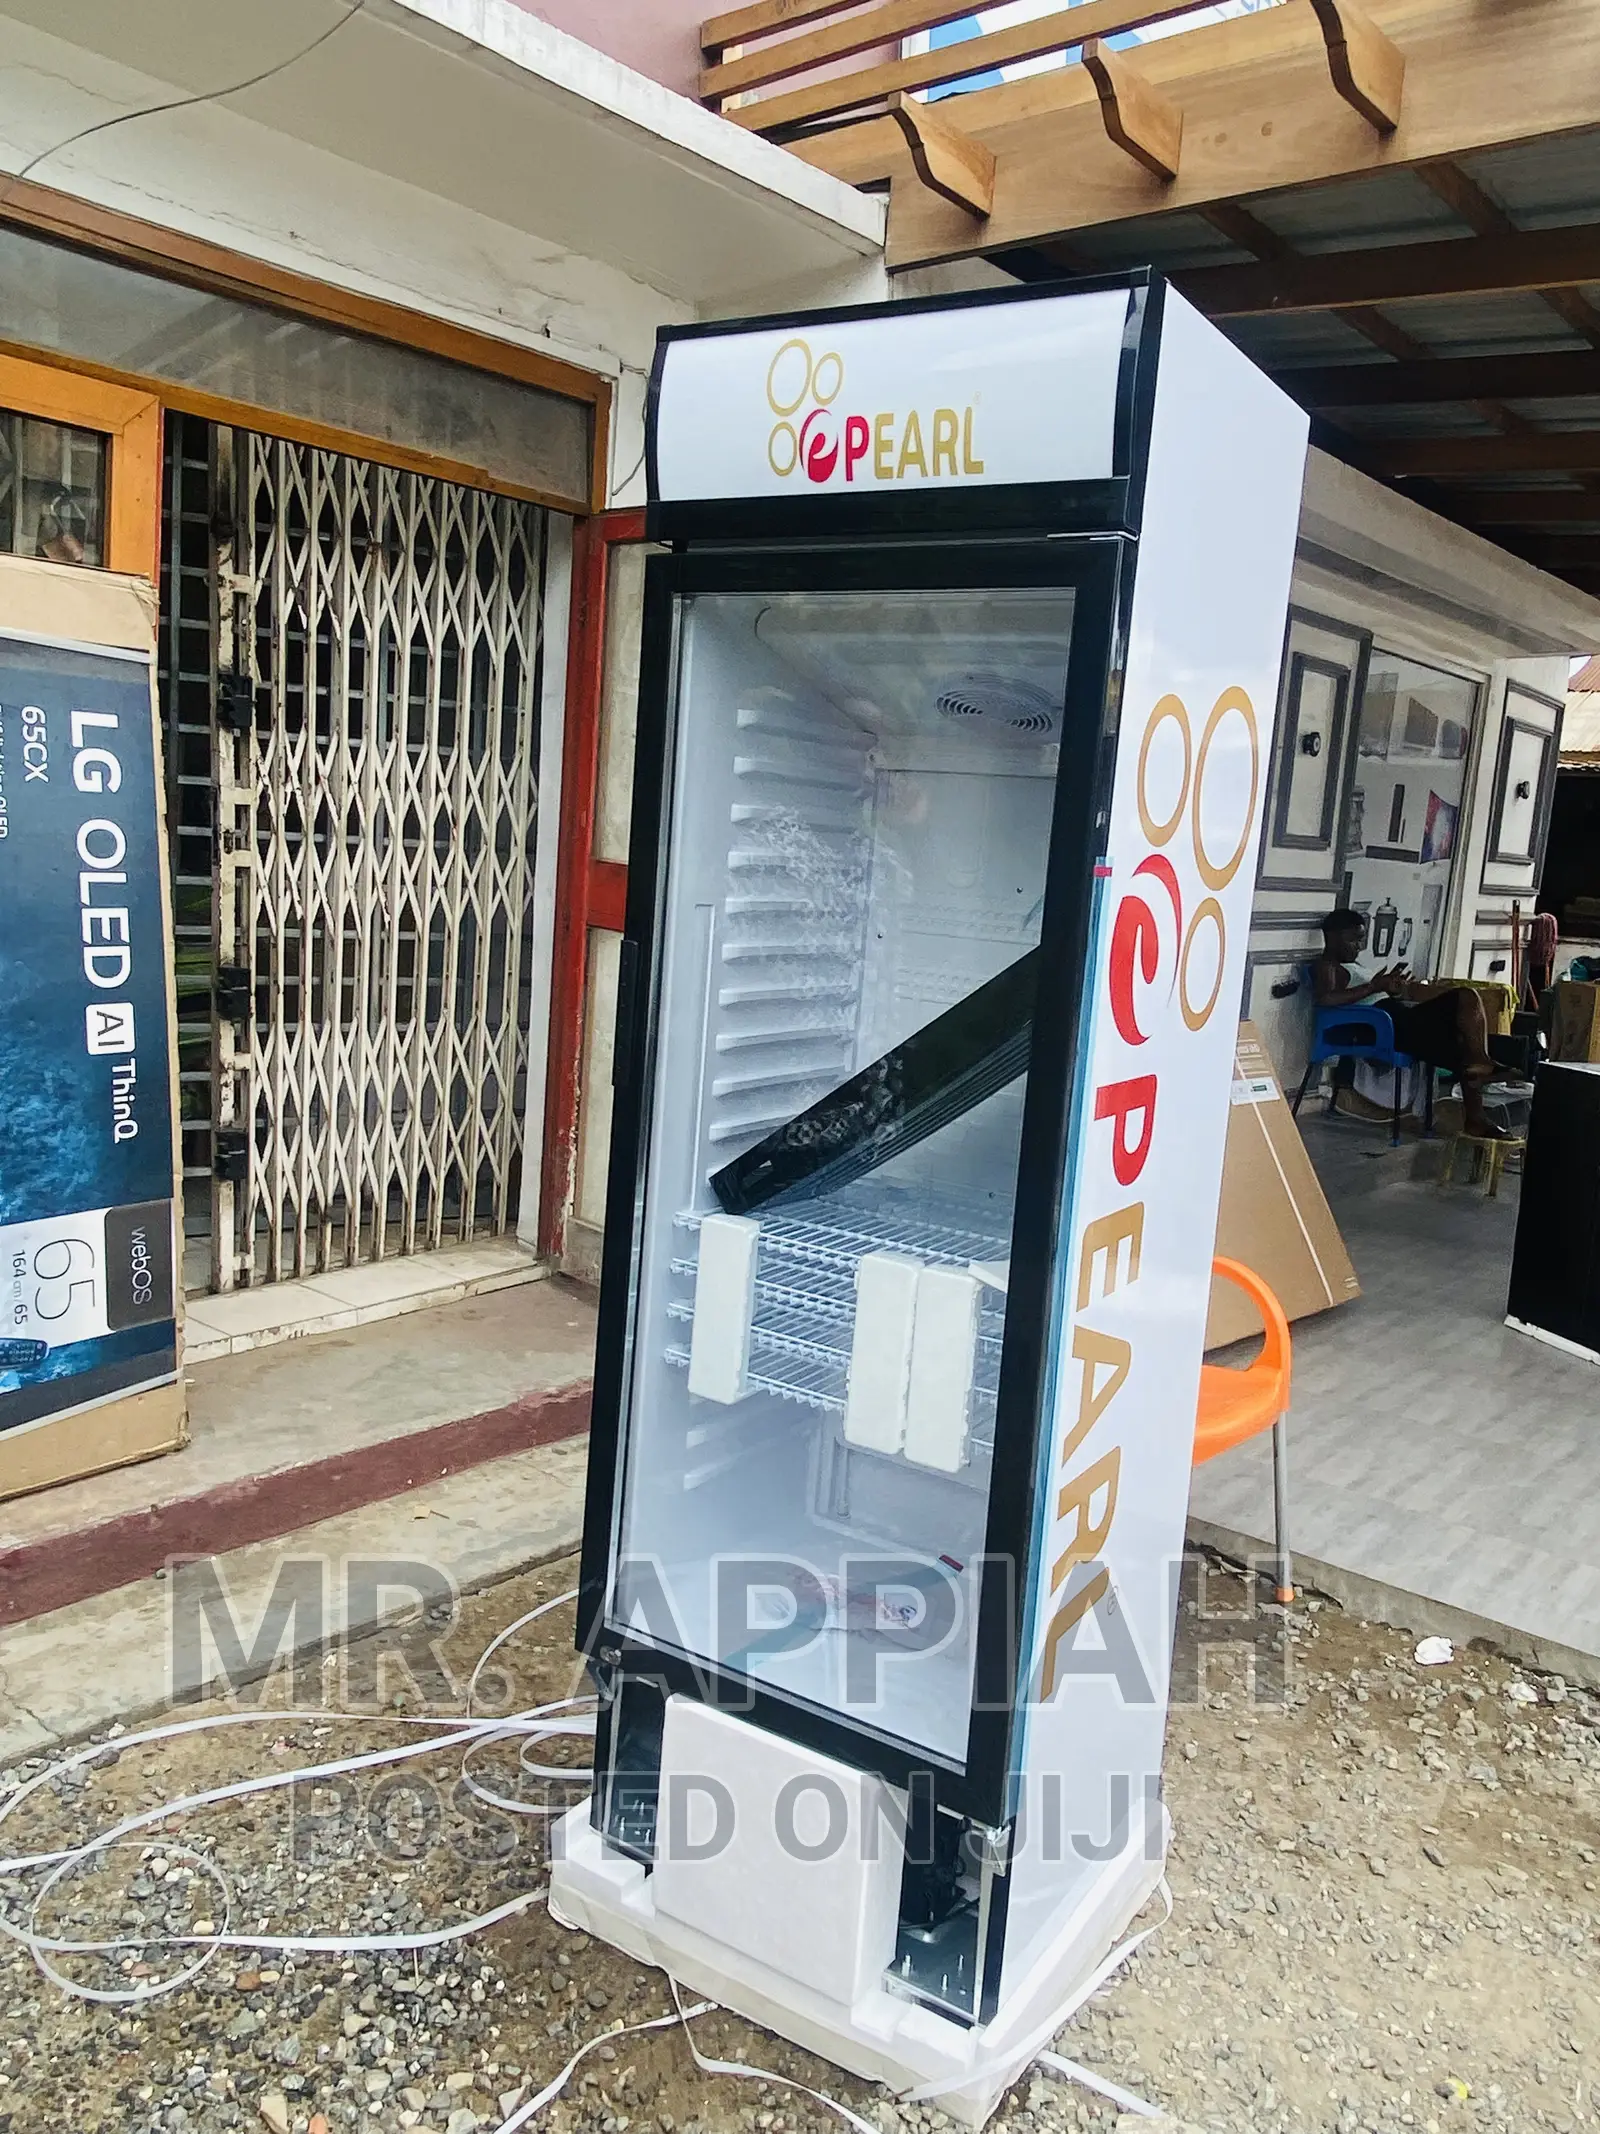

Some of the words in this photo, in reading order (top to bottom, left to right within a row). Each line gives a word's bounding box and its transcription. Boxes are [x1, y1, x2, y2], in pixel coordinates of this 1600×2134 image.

[21, 705, 49, 783] 65CX
[70, 710, 122, 794] LG
[76, 817, 132, 990] OLED
[96, 1010, 125, 1047] AI
[112, 1057, 139, 1145] ThinQ
[33, 1238, 96, 1320] 65
[131, 1226, 153, 1305] webOS
